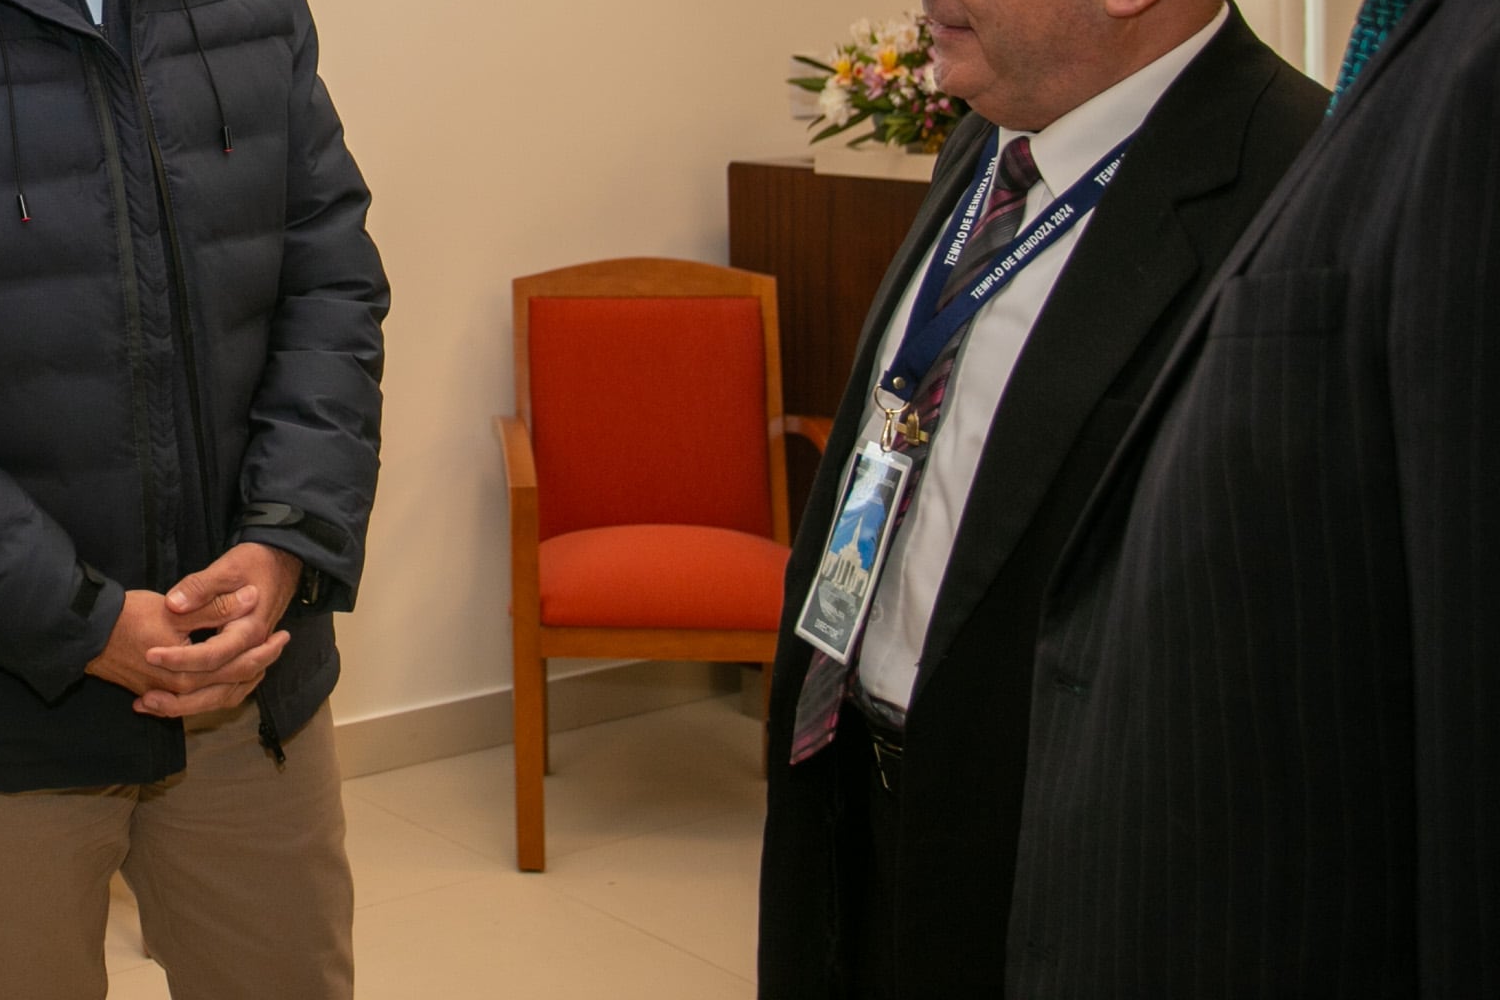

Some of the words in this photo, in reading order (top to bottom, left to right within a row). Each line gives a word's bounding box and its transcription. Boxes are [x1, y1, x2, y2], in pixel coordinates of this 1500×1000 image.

[965, 176, 991, 217] MENDOZA
[960, 218, 973, 231] DE
[944, 231, 968, 266] TEMPLO
[970, 267, 1005, 299] TEMPLO
[1001, 256, 1018, 271] DE
[1013, 221, 1056, 260] MENDOZA
[1050, 203, 1074, 226] 2024
